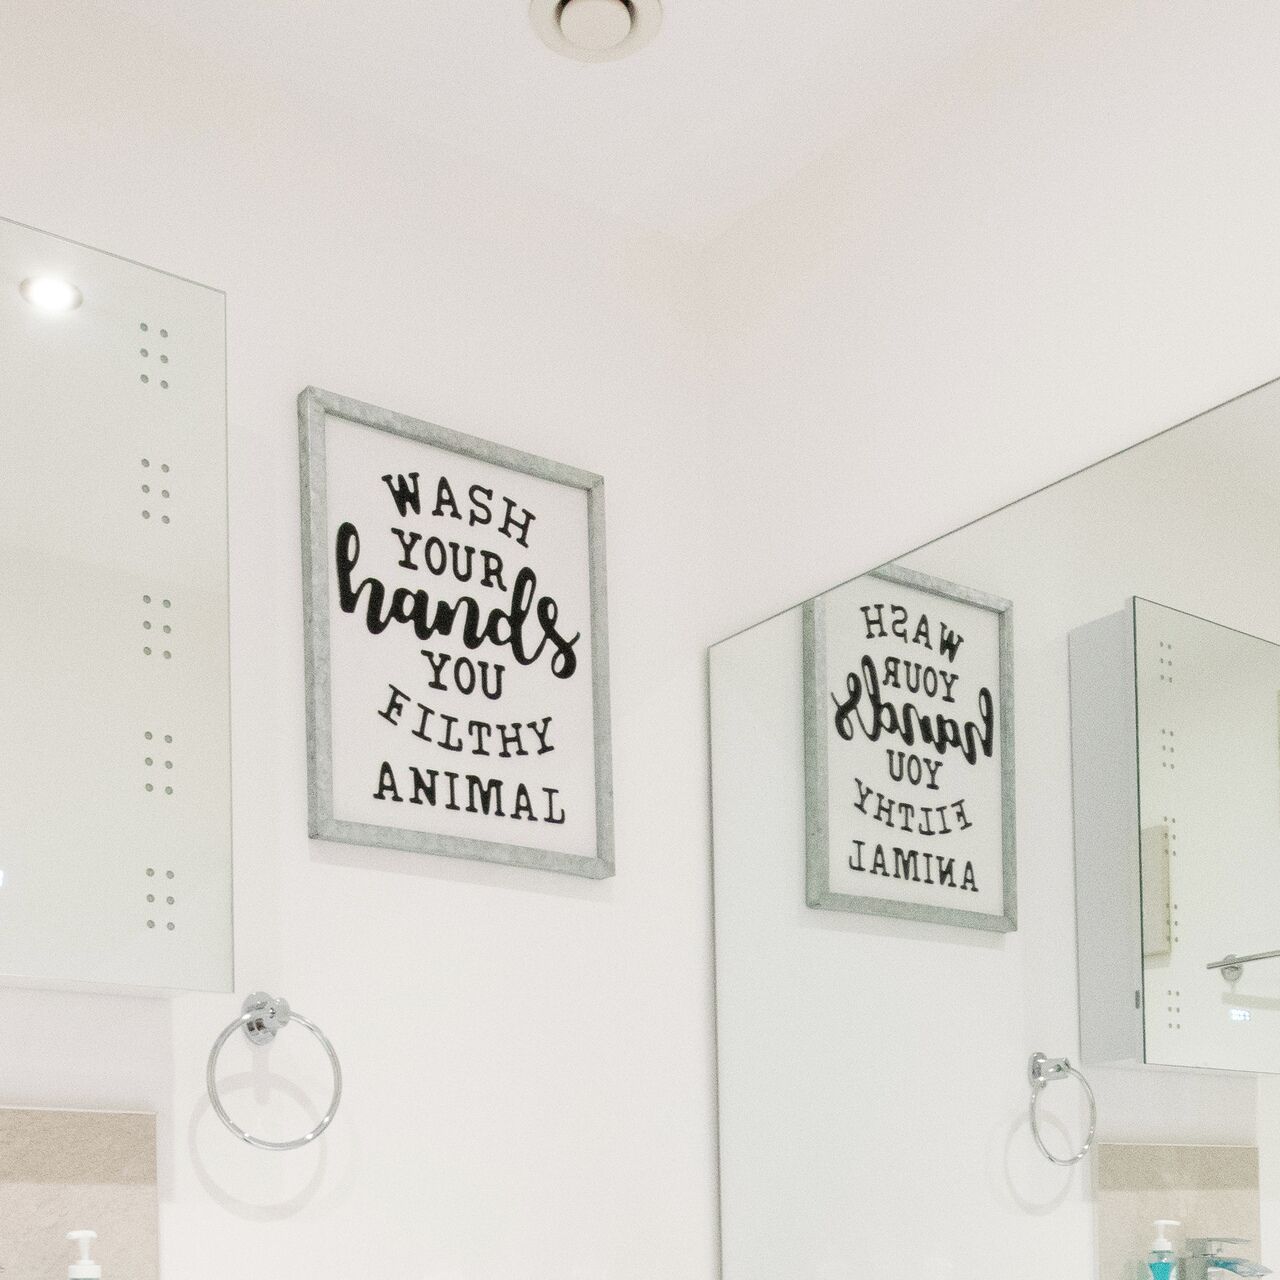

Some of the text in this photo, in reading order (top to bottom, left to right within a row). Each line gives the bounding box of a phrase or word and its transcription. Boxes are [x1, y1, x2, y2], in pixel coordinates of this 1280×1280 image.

[382, 471, 536, 547] WASH
[392, 527, 507, 591] YOUR
[336, 521, 580, 679] hands
[421, 649, 505, 700] YOU
[379, 684, 555, 757] FILTHY
[373, 761, 565, 824] ANIMAL
